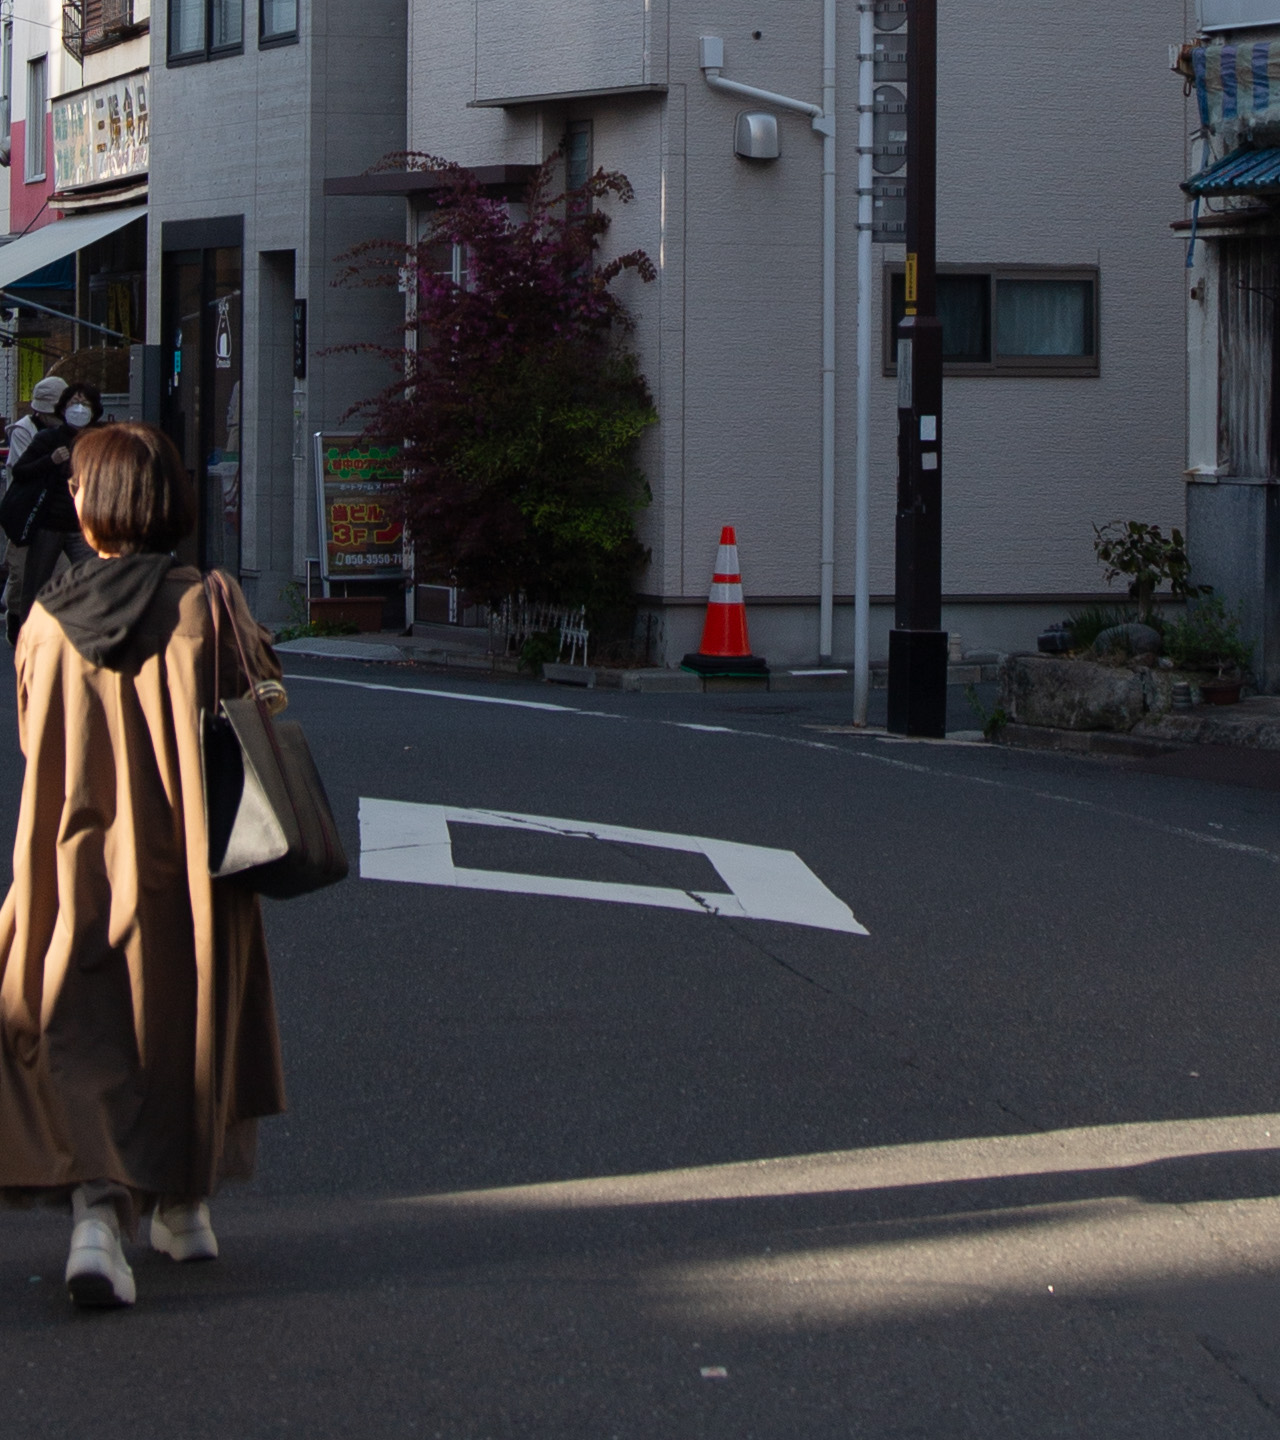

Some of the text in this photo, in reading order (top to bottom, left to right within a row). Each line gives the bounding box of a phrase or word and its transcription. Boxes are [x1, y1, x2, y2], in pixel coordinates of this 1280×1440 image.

[332, 505, 383, 521] 当ビル
[333, 523, 366, 545] 3F
